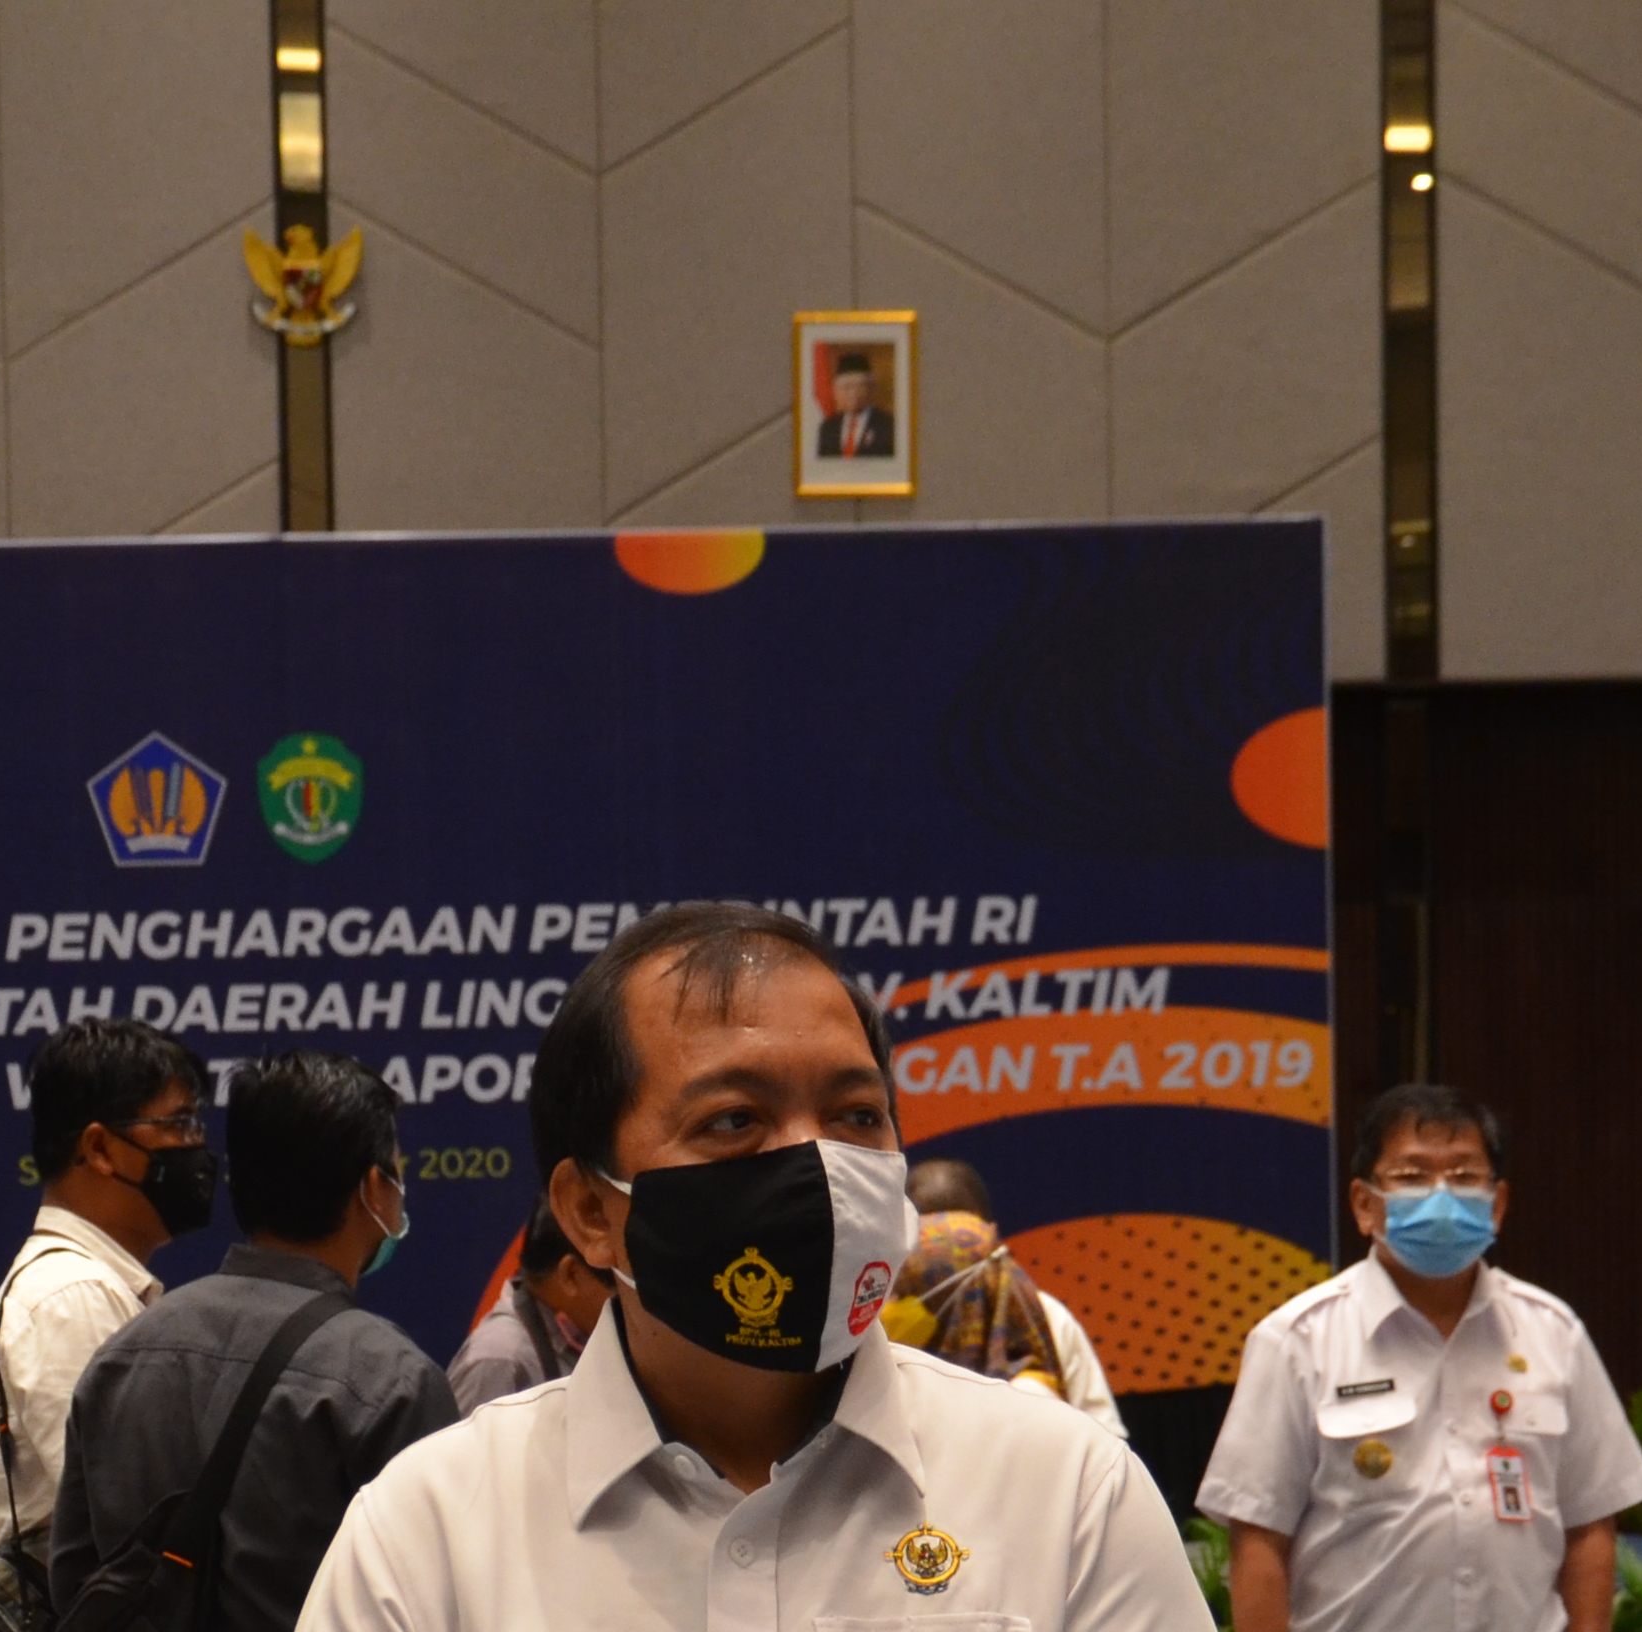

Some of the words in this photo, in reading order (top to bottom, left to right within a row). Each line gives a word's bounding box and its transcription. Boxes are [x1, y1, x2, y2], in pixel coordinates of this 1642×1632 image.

[5, 905, 517, 961] PENGHARGAAN
[970, 895, 1038, 944] RI
[131, 981, 407, 1034] DAERAH
[924, 967, 1170, 1019] KALTIM
[1050, 1043, 1144, 1091] T.A
[1159, 1038, 1314, 1089] 2019
[418, 1147, 511, 1181] 2020
